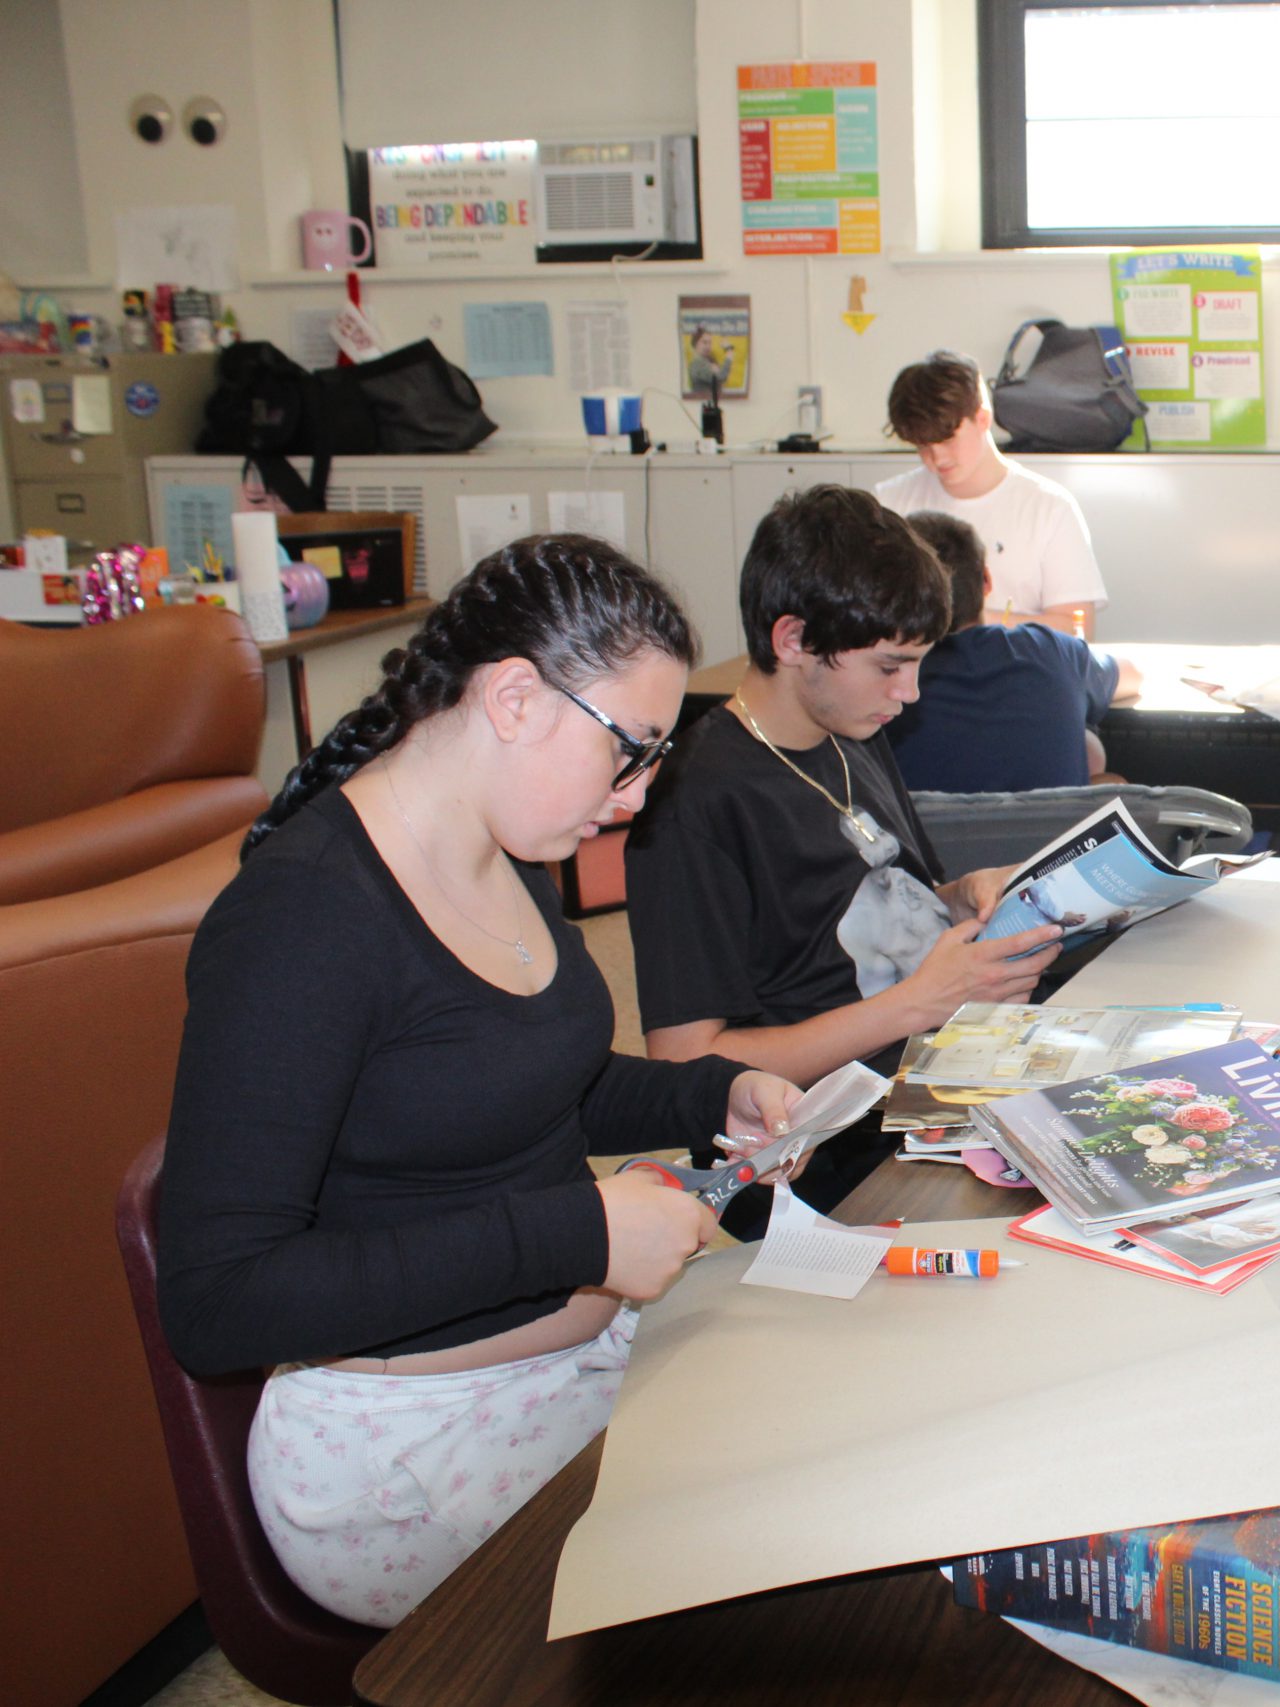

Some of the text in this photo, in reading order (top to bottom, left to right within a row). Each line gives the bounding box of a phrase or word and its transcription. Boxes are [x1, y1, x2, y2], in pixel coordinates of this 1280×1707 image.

[376, 199, 528, 229] BEING DEPENDABLE
[1137, 253, 1233, 269] LET'S WRITE
[1213, 298, 1242, 311] DRAFT
[1136, 347, 1176, 357] REVISE
[1207, 355, 1250, 366] Proofread
[1158, 404, 1195, 416] PUBLISH
[1091, 869, 1116, 892] MEETS
[1102, 864, 1128, 888] WHERE
[1047, 1118, 1119, 1188] Summer Delights
[1064, 1559, 1073, 1596] PAST MASTER
[1091, 1572, 1100, 1586] CALL
[1107, 1555, 1116, 1581] FLOWERS
[1108, 1581, 1117, 1592] FOR
[1213, 1570, 1221, 1593] EIGHT
[1198, 1586, 1211, 1649] OF THE 1960s
[1225, 1575, 1247, 1660] FICTION
[1252, 1582, 1273, 1666] SCIENCE
[1214, 1625, 1222, 1656] NOVELS
